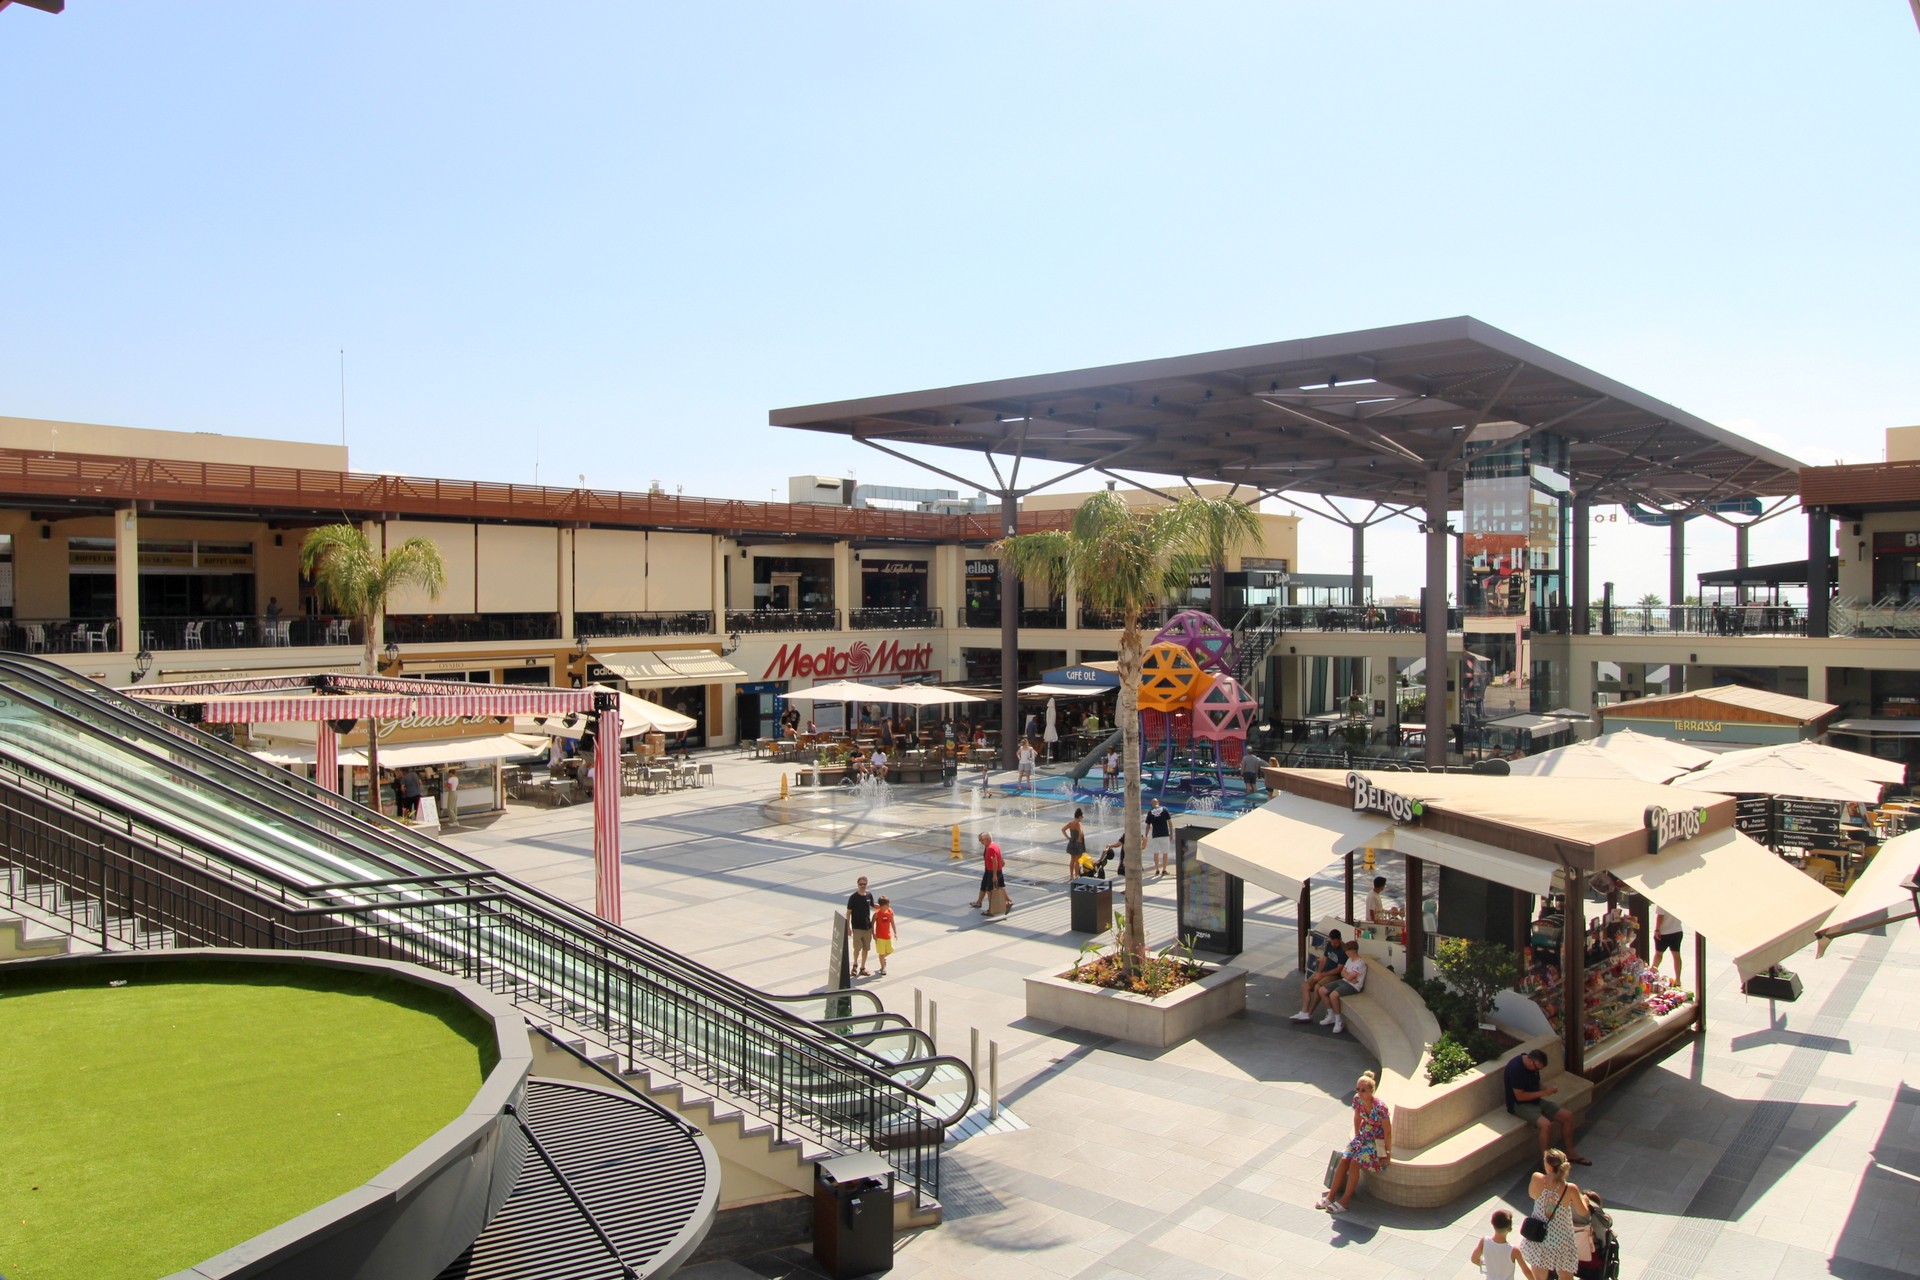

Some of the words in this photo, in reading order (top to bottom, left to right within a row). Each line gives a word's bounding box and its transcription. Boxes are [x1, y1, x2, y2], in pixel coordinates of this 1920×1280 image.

[1904, 533, 1920, 547] B
[763, 643, 850, 679] Media
[867, 639, 933, 673] Markt
[1066, 670, 1082, 681] CAFÉ
[1084, 670, 1096, 681] OLÉ
[1346, 772, 1413, 821] BELROS
[1783, 802, 1792, 812] 2
[1651, 806, 1700, 848] BELROS
